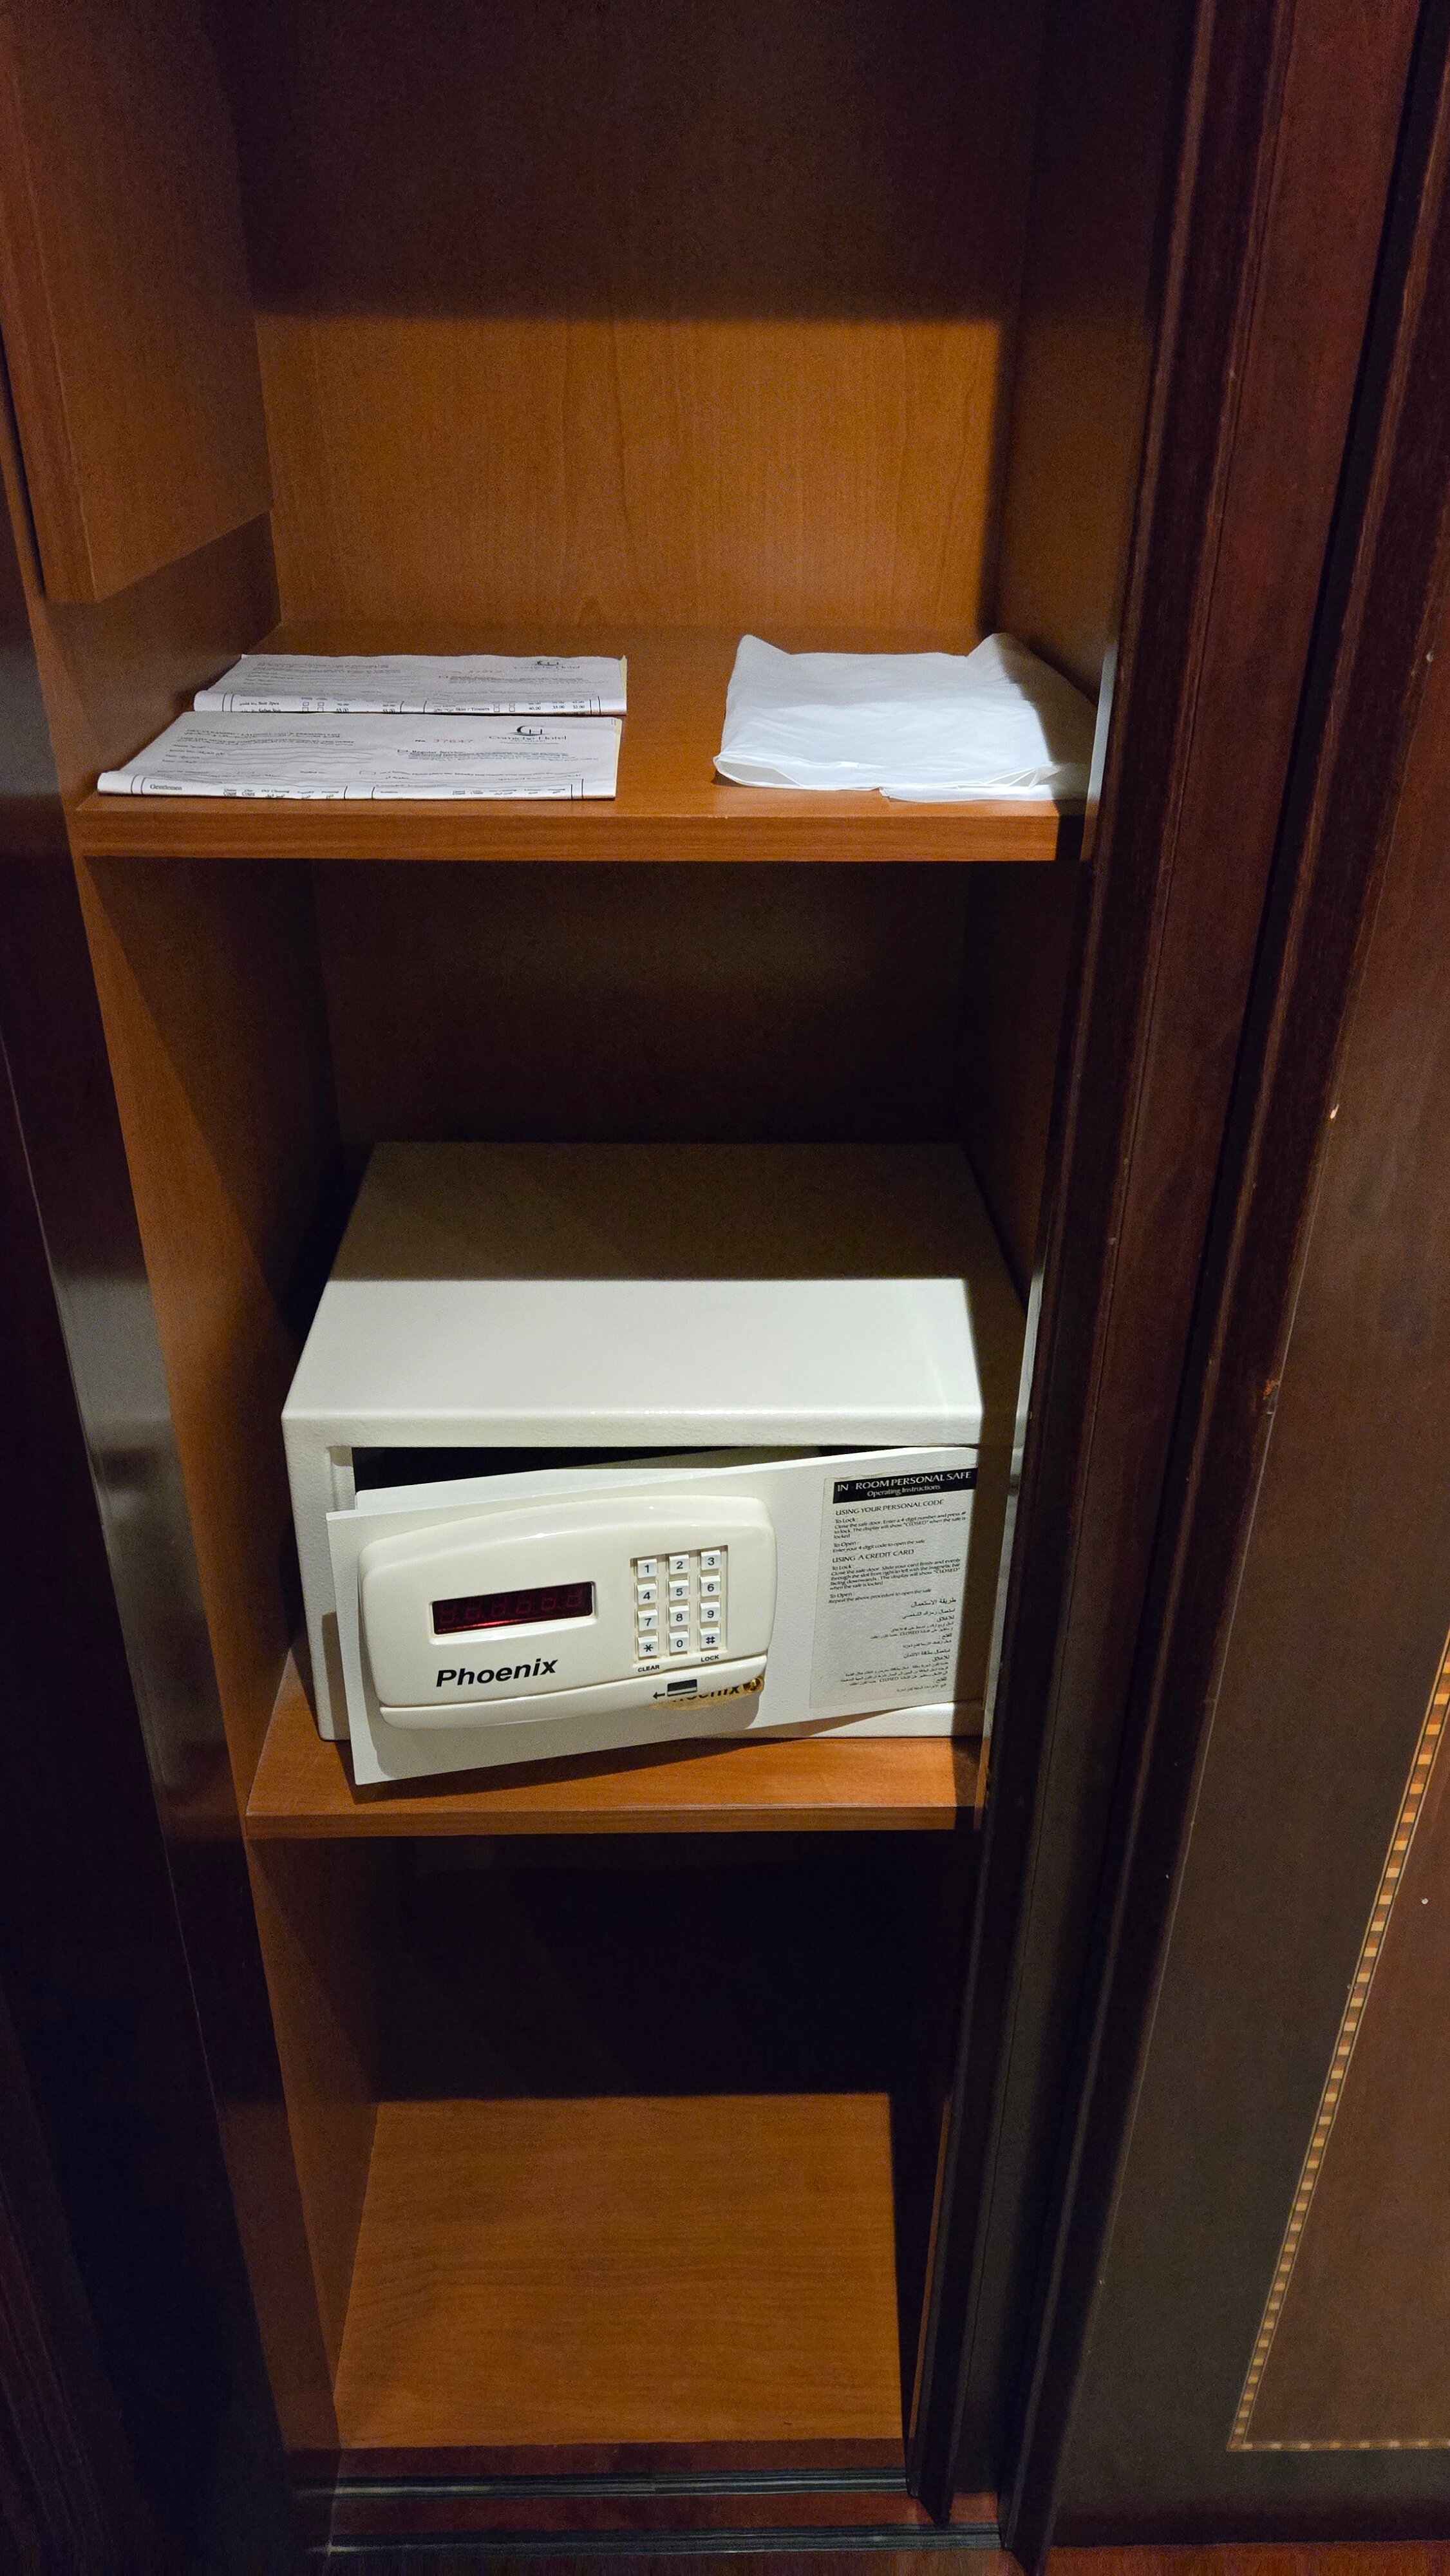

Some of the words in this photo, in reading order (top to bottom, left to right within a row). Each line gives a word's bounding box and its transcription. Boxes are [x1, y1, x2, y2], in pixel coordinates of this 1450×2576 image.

[837, 1484, 849, 1492] IN
[855, 1480, 889, 1490] ROOM
[890, 1474, 945, 1486] PERSONAL
[946, 1471, 972, 1481] SAFE
[867, 1488, 901, 1498] Operating
[902, 1484, 941, 1493] Instructions
[835, 1508, 860, 1516] USING
[882, 1502, 922, 1511] PERSONAL
[644, 1564, 650, 1573] 1
[676, 1560, 683, 1569] 2
[708, 1557, 715, 1566] 3
[643, 1591, 651, 1600] 4
[676, 1587, 683, 1596] 5
[707, 1584, 715, 1592] 6
[644, 1617, 652, 1626] 7
[676, 1613, 683, 1622] 8
[707, 1610, 715, 1618] 9
[676, 1640, 683, 1648] 0
[705, 1636, 716, 1645] #
[701, 1654, 720, 1663] LOCK
[436, 1658, 559, 1687] Phoenix
[637, 1664, 661, 1672] CLEAR
